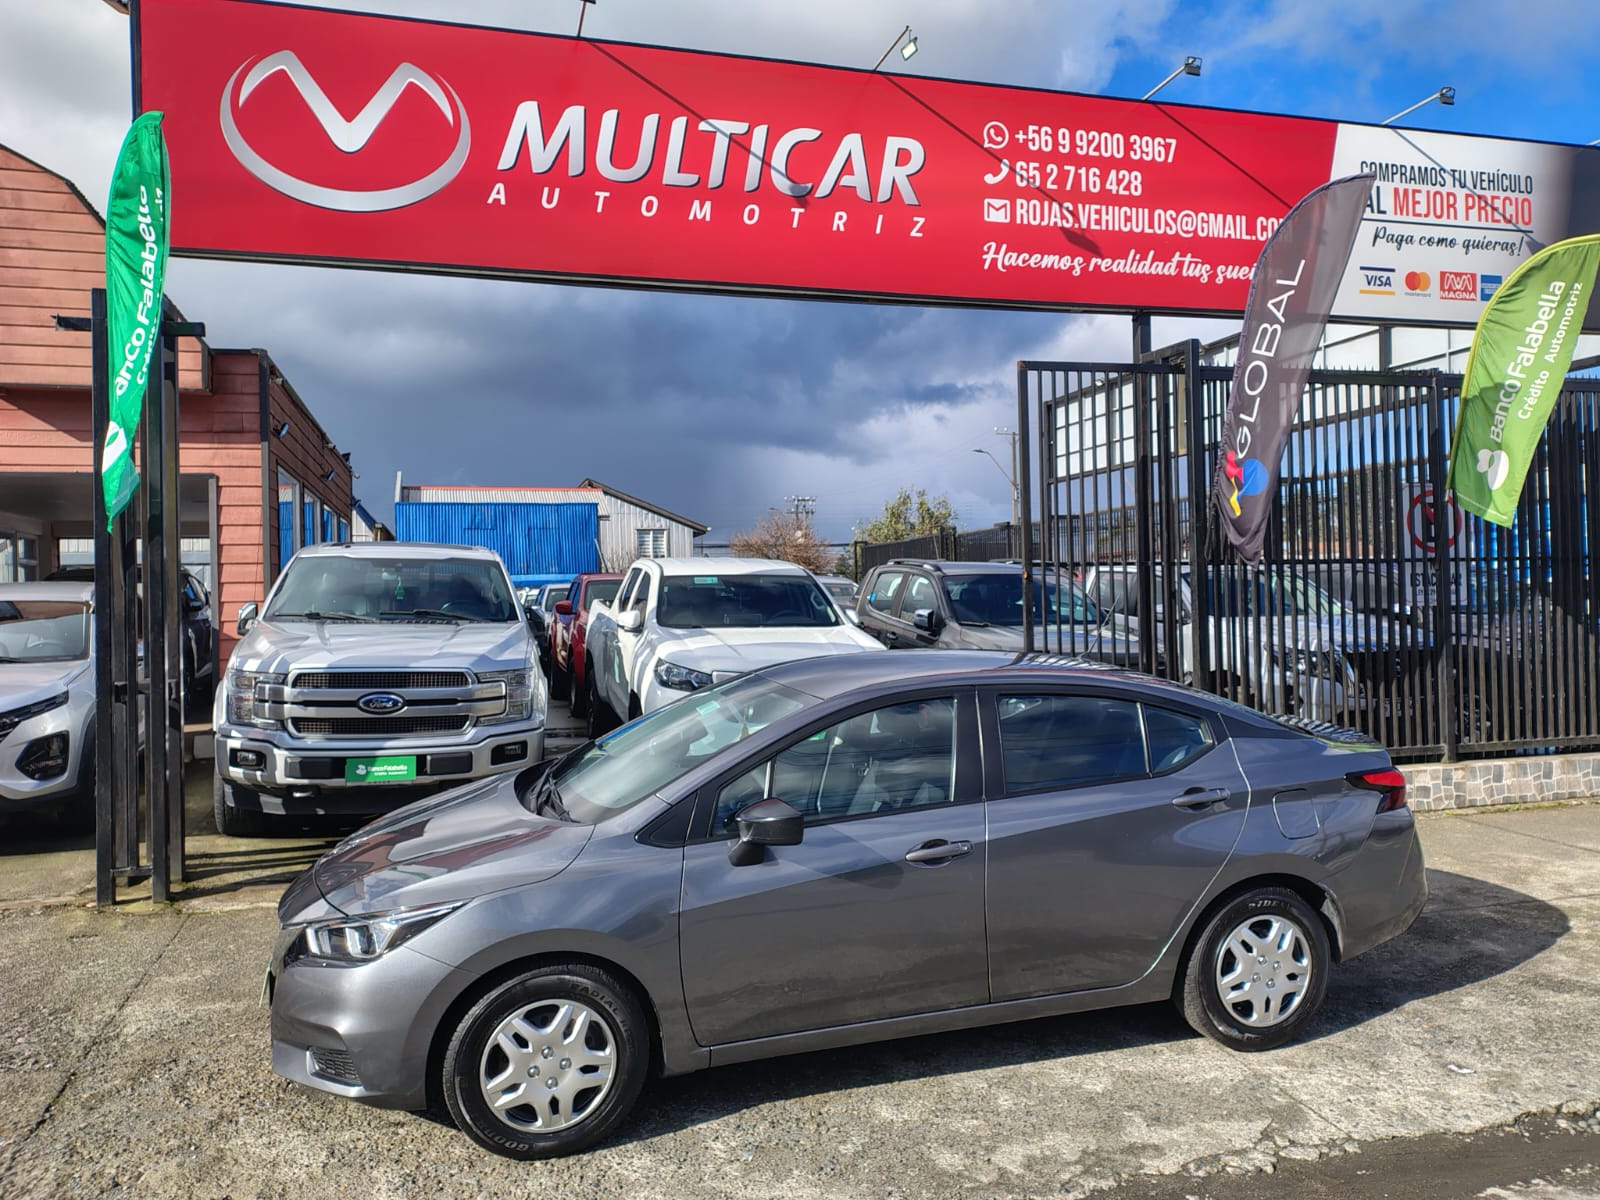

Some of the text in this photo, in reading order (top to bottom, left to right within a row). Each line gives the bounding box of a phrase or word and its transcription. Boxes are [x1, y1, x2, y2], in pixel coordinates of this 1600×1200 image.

[497, 101, 926, 206] MULTICAR
[1015, 125, 1177, 163] +56 9 9200 3967
[1015, 160, 1142, 196] 65 2 716 428
[1450, 169, 1467, 189] TU
[1472, 168, 1534, 194] VEHÍCULO
[487, 183, 926, 237] AUTOMOTRIZ
[1393, 187, 1459, 221] MEJOR
[1465, 193, 1533, 226] PRECIO
[1372, 226, 1525, 256] Paga como quieras!
[982, 241, 1087, 276] Hacemos
[1088, 249, 1179, 276] realidad
[1173, 255, 1212, 283] tus
[1364, 274, 1392, 287] VISA
[1440, 290, 1477, 299] MAGNA
[1236, 259, 1306, 459] GLOBAL
[1490, 281, 1566, 443] Banco Falabella
[1518, 282, 1583, 420] Crédito Automotriz
